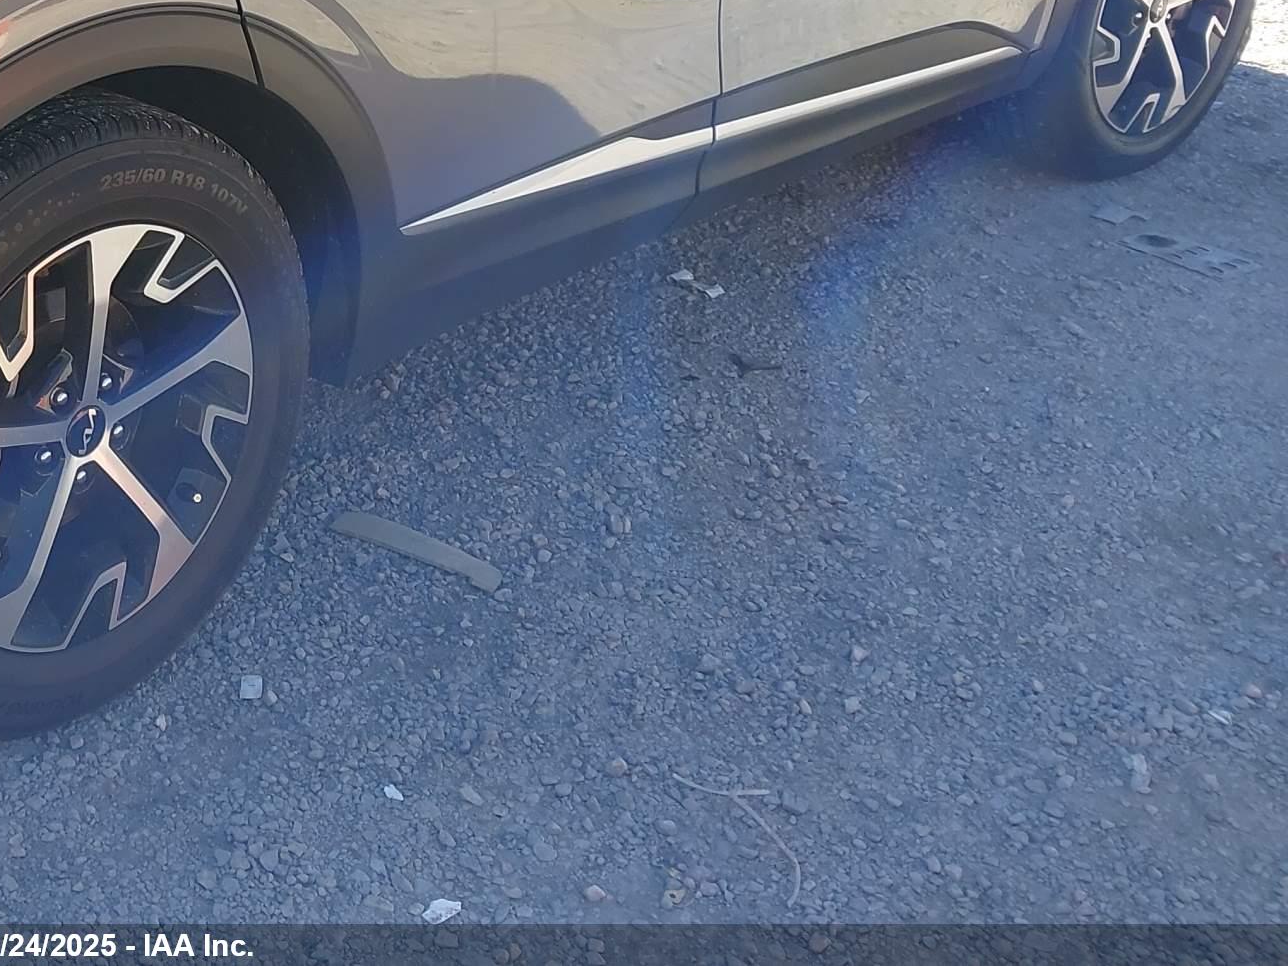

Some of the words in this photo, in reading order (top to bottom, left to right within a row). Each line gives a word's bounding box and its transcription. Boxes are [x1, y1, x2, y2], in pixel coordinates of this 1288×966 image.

[100, 167, 166, 191] 235/60
[171, 169, 206, 191] R18
[211, 183, 249, 215] 107V
